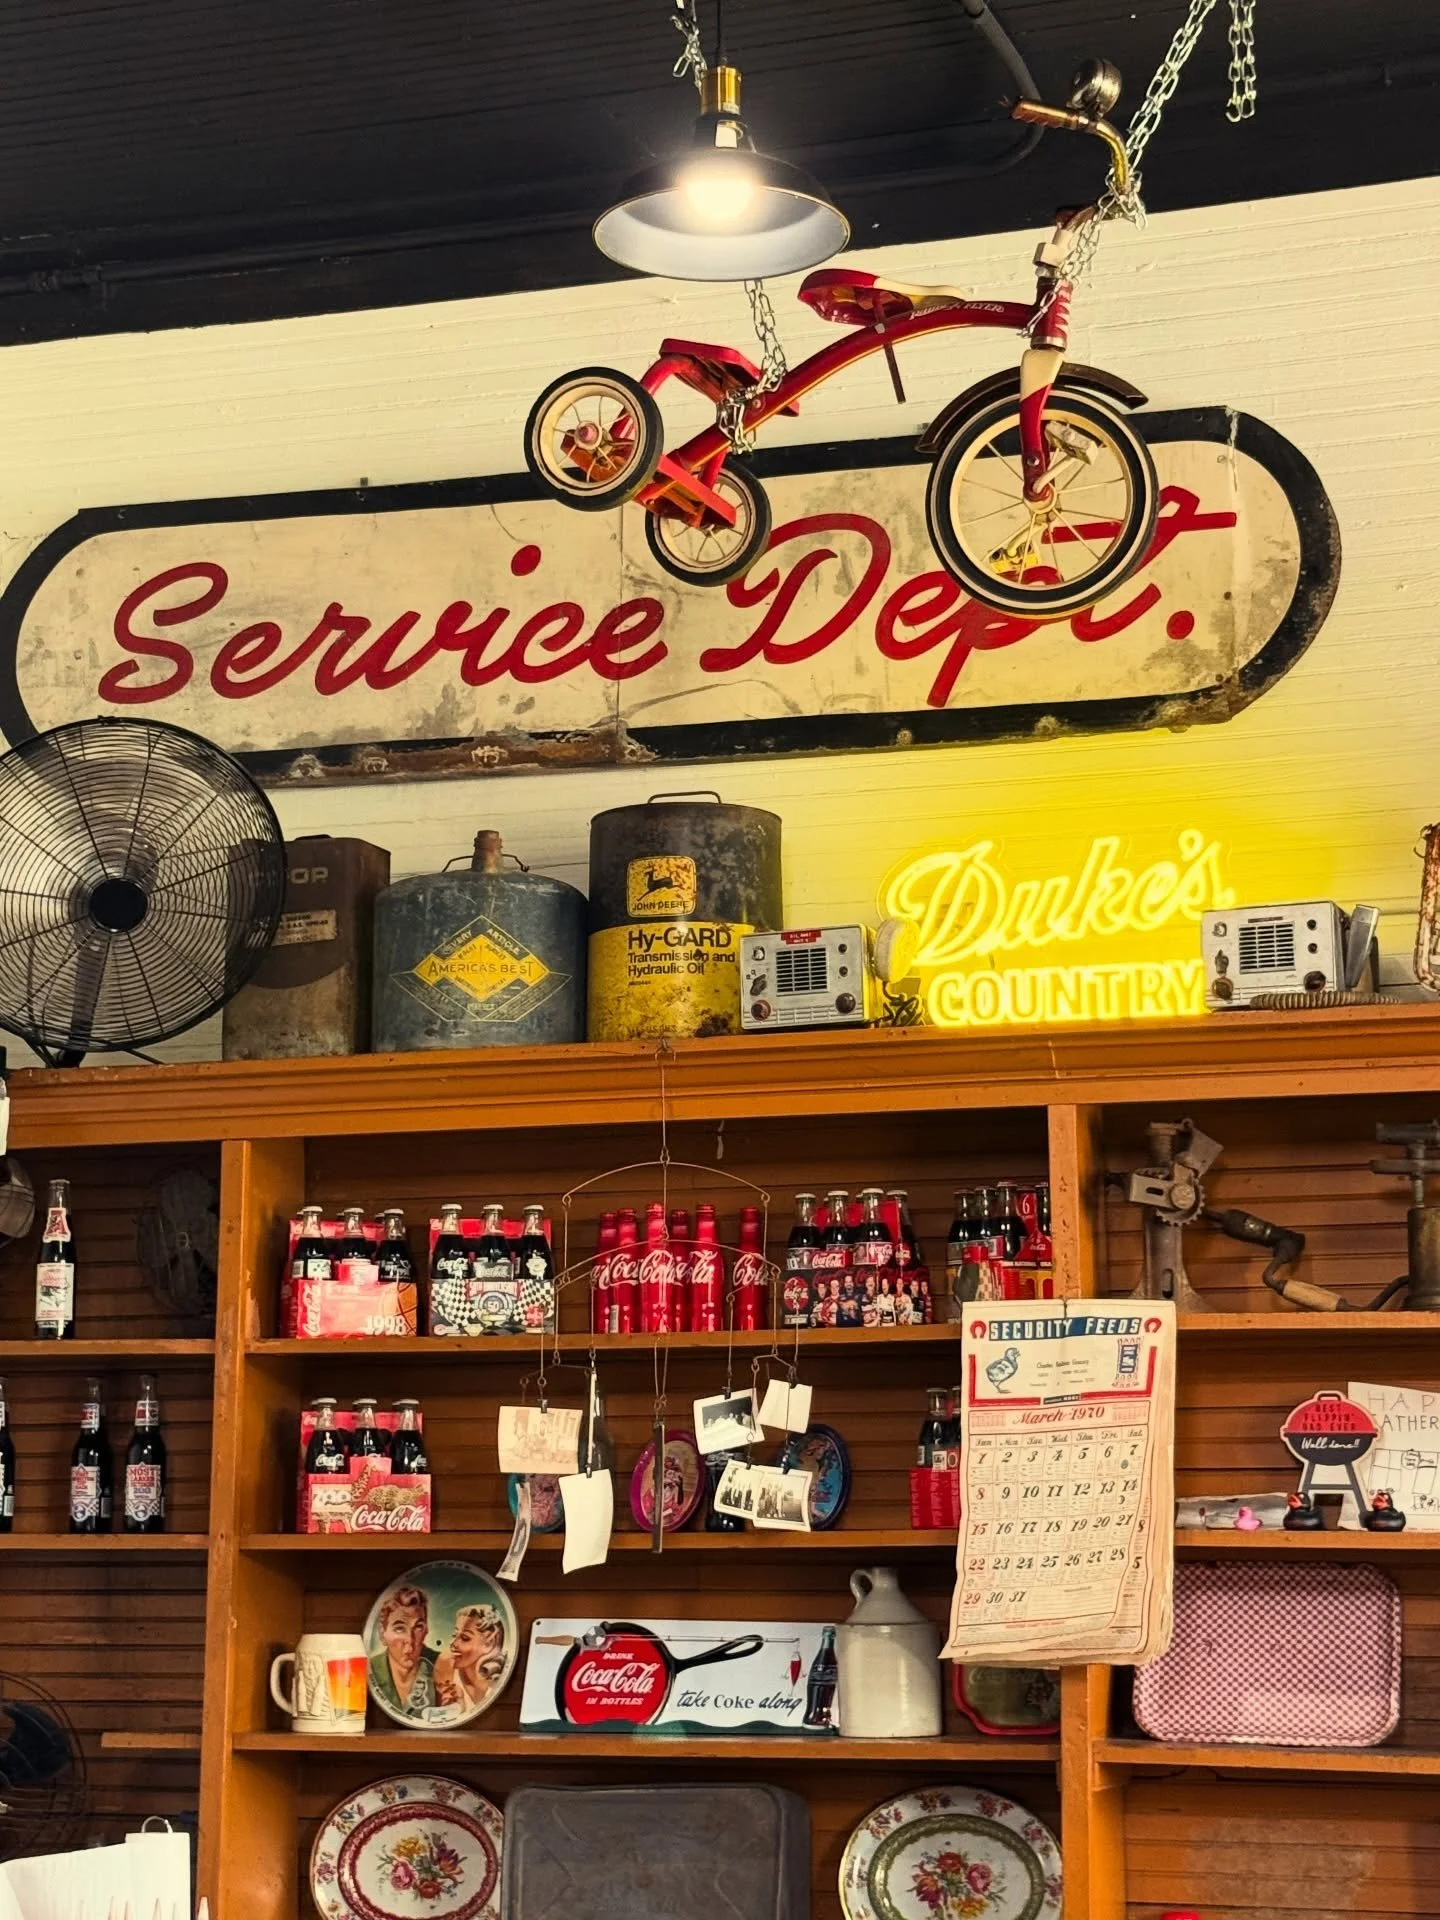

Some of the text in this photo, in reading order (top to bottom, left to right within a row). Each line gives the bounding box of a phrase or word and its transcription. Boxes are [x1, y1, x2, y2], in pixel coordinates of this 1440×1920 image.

[99, 486, 1236, 708] Service Dept.
[632, 900, 689, 911] JOHN DEERE
[886, 829, 1234, 966] Duke's
[487, 927, 520, 954] ARTICLE
[628, 927, 732, 952] Hy-GARD
[628, 951, 735, 965] Transmission and
[501, 961, 534, 977] BEST
[628, 962, 704, 977] Hydraulic Oil
[928, 960, 1208, 1028] COUNTRY
[364, 1315, 406, 1336] 1998
[991, 1318, 1141, 1340] SECURITY FEEDS
[1303, 1412, 1354, 1422] FLIPPIN'
[1315, 1403, 1342, 1413] BEST
[1302, 1422, 1356, 1431] DAD EVER
[977, 1443, 1139, 1464] 1 2 3 4 5 6 7
[1301, 1436, 1328, 1450] Well
[976, 1479, 1138, 1500] 8 9 10 11 12 13 14
[350, 1504, 426, 1531] Coca-Cola
[971, 1513, 1134, 1536] 15 16 17 18 19 20 21
[968, 1547, 1126, 1571] 22 23 24 25 26 27 28
[963, 1590, 1027, 1605] 29 30 31
[602, 1652, 635, 1660] DRINK
[571, 1660, 661, 1694] Coca-Cola
[586, 1697, 645, 1705] IN BOTTLES
[676, 1689, 803, 1717] take Coke along
